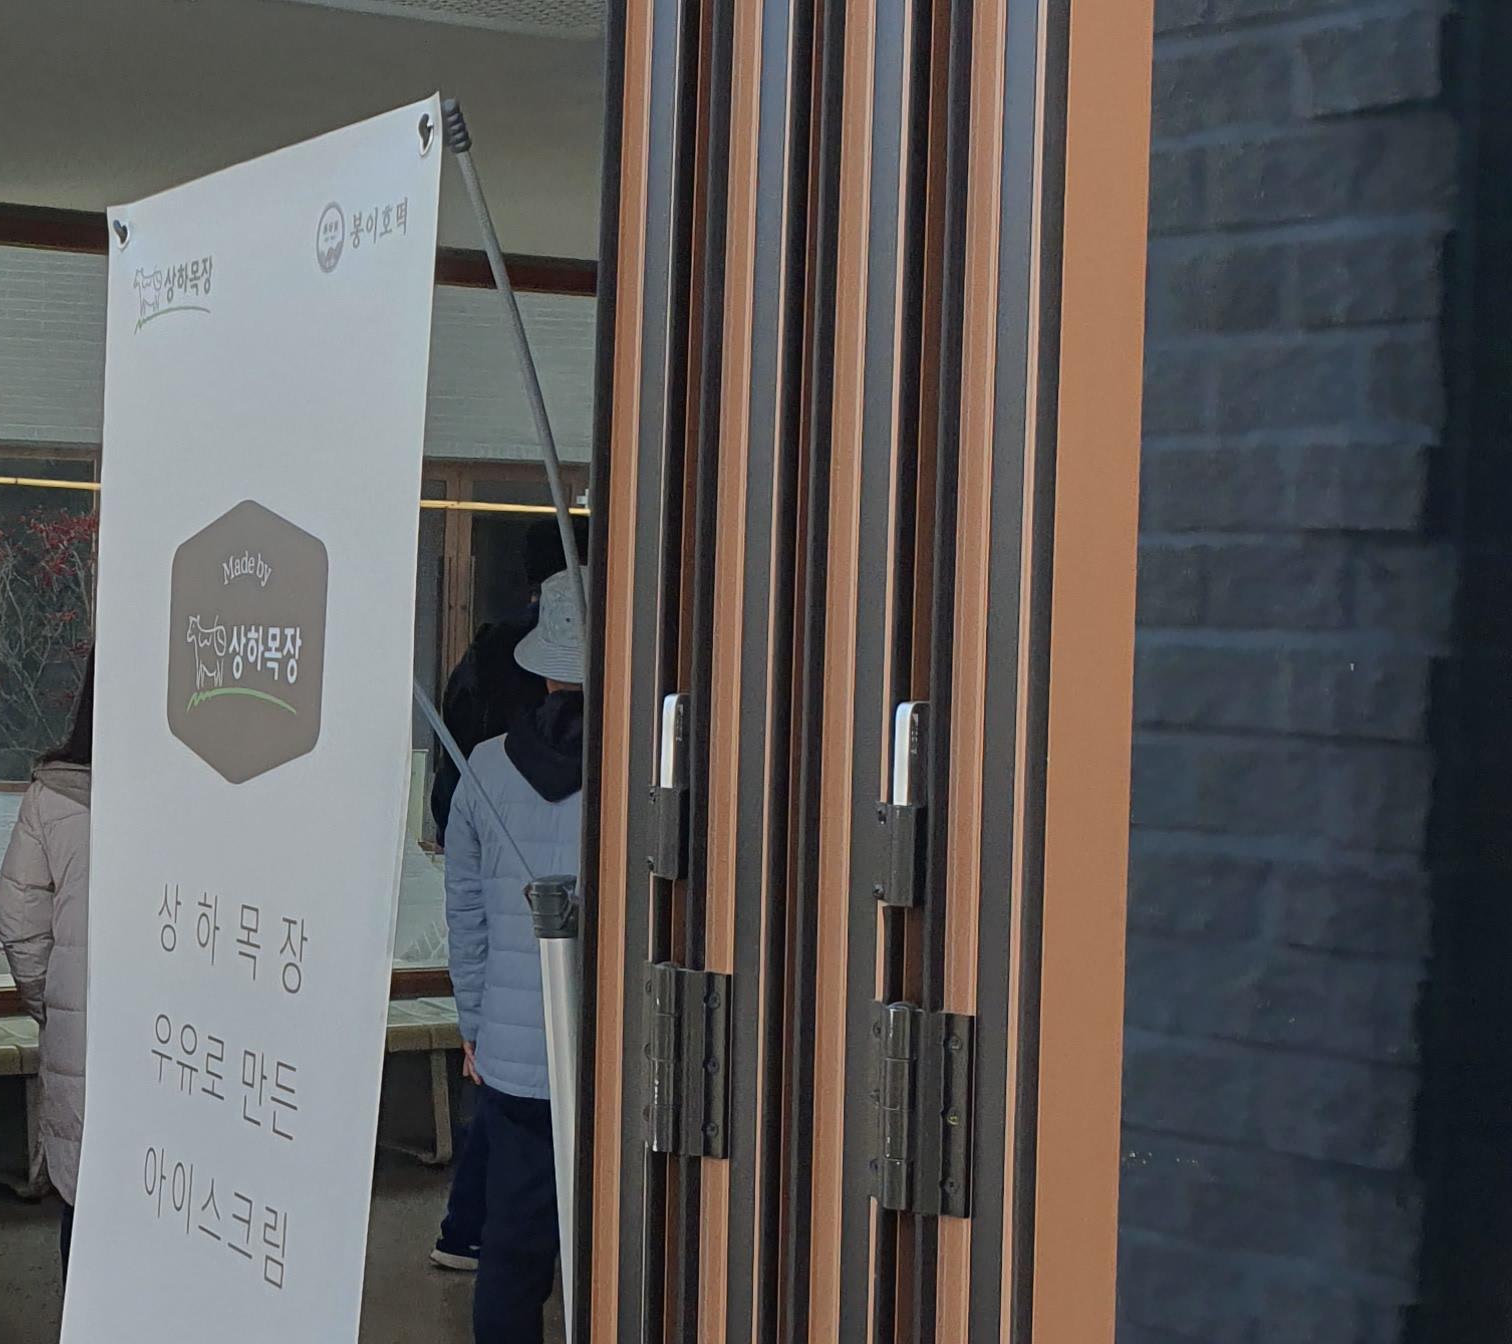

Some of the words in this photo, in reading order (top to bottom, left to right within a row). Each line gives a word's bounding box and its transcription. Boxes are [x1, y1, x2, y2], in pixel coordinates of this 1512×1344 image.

[350, 196, 408, 249] 봉이호떡
[164, 255, 213, 303] 상하목장
[222, 550, 255, 585] Made
[256, 552, 272, 587] by
[228, 625, 302, 684] 상하목장
[158, 882, 308, 994] 상하목장
[151, 1013, 226, 1101] 우유로
[241, 1049, 299, 1141] 만든
[144, 1146, 289, 1290] 아이스크림
